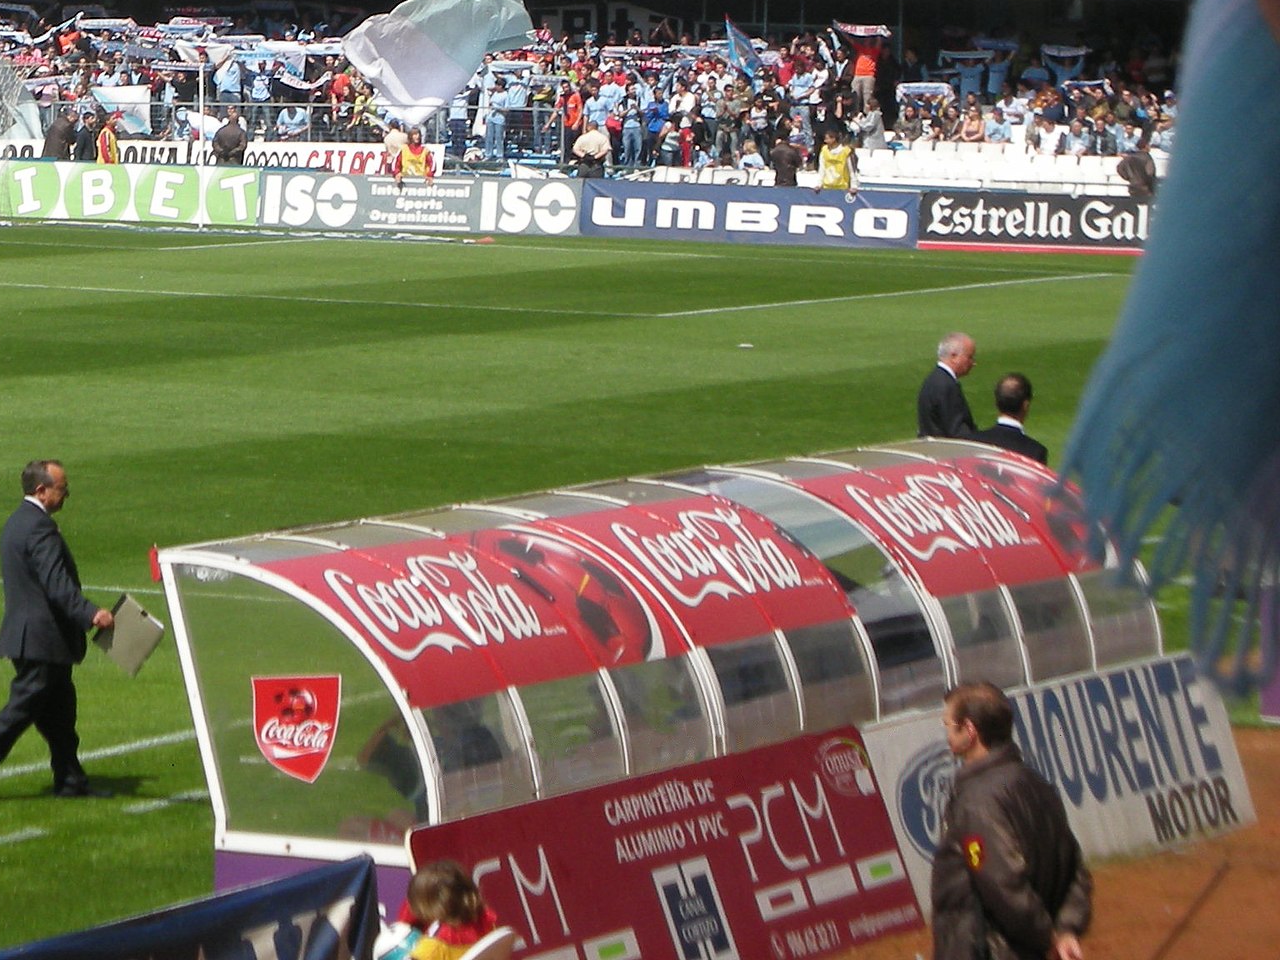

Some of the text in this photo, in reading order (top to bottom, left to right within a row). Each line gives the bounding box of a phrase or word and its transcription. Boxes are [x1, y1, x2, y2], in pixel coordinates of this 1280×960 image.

[262, 174, 358, 228] ISO
[371, 183, 471, 199] International
[395, 197, 443, 212] Sports
[480, 181, 577, 235] ISO
[926, 196, 1072, 238] Estrella
[604, 777, 716, 827] CARPINTERÍA DE
[726, 772, 847, 883] PCM
[1145, 775, 1240, 842] MOTOR
[615, 812, 730, 864] ALUMINIO Y PVC
